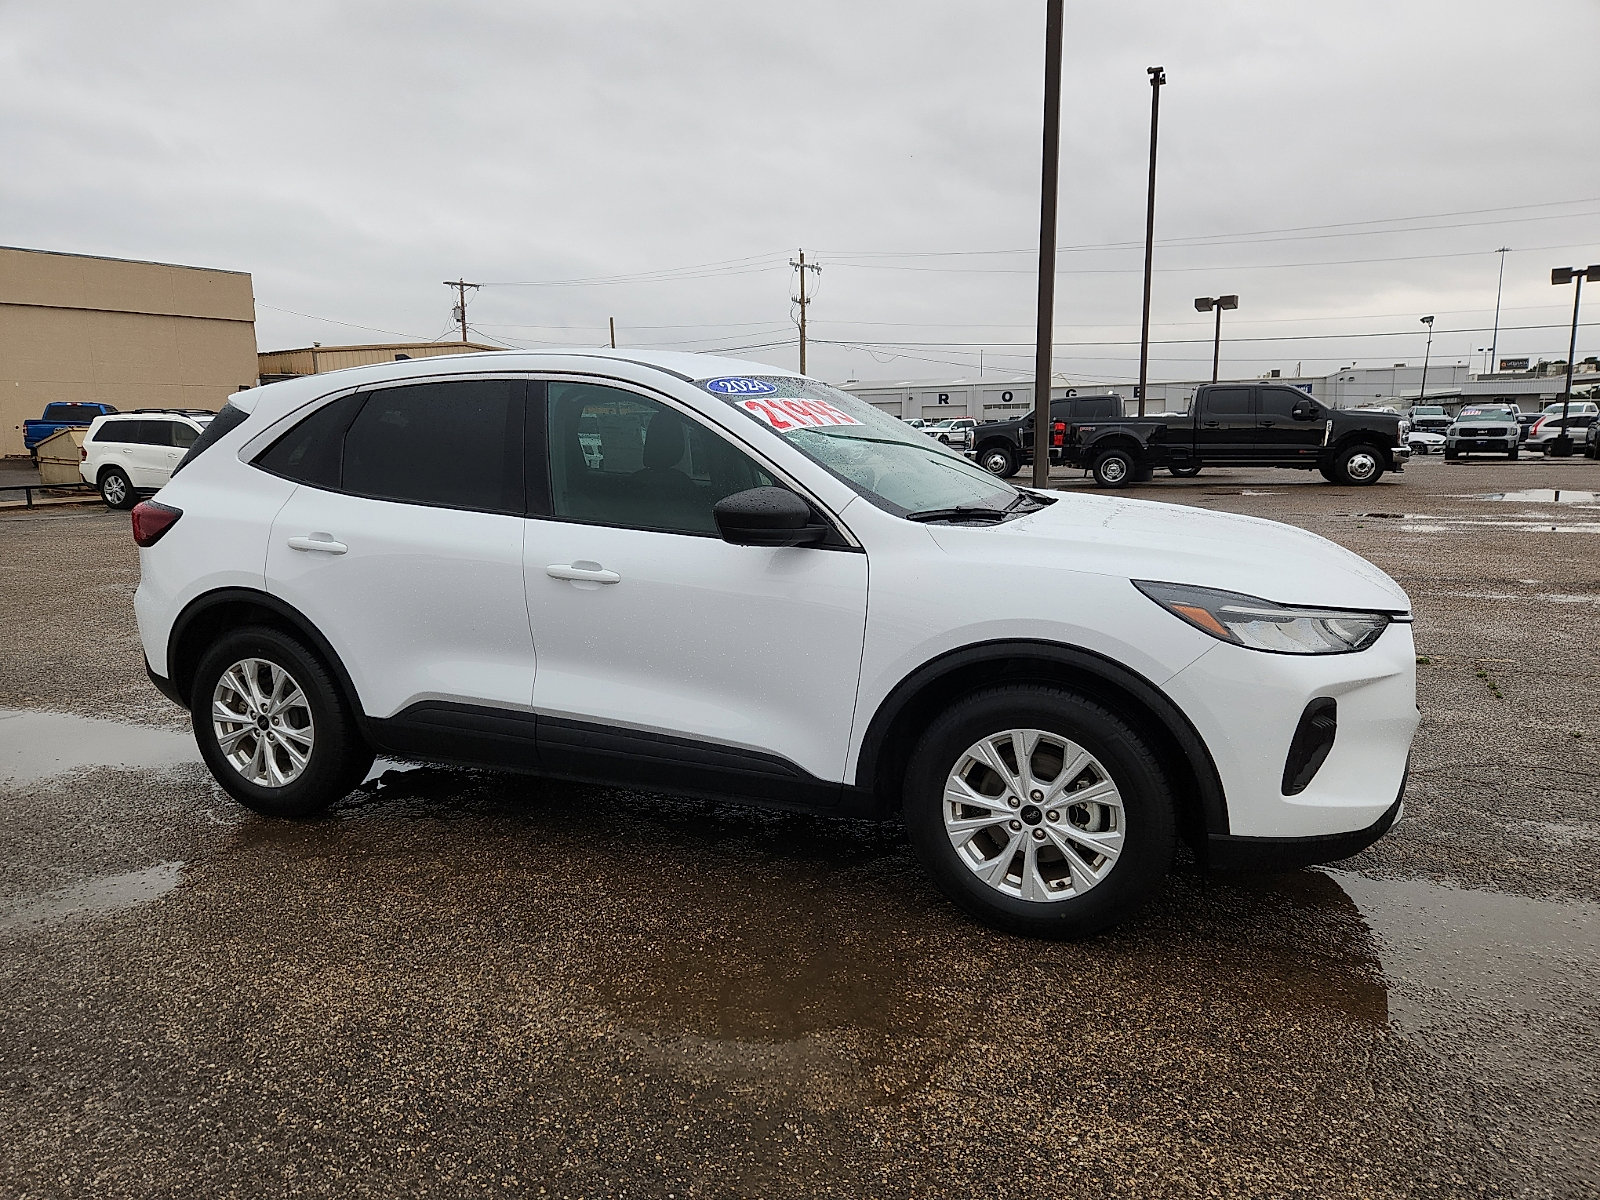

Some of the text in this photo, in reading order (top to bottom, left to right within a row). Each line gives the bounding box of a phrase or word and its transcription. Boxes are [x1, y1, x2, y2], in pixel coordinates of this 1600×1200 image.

[718, 380, 770, 393] 2024
[938, 394, 949, 405] R
[1001, 391, 1014, 402] O
[744, 399, 855, 429] 21995
